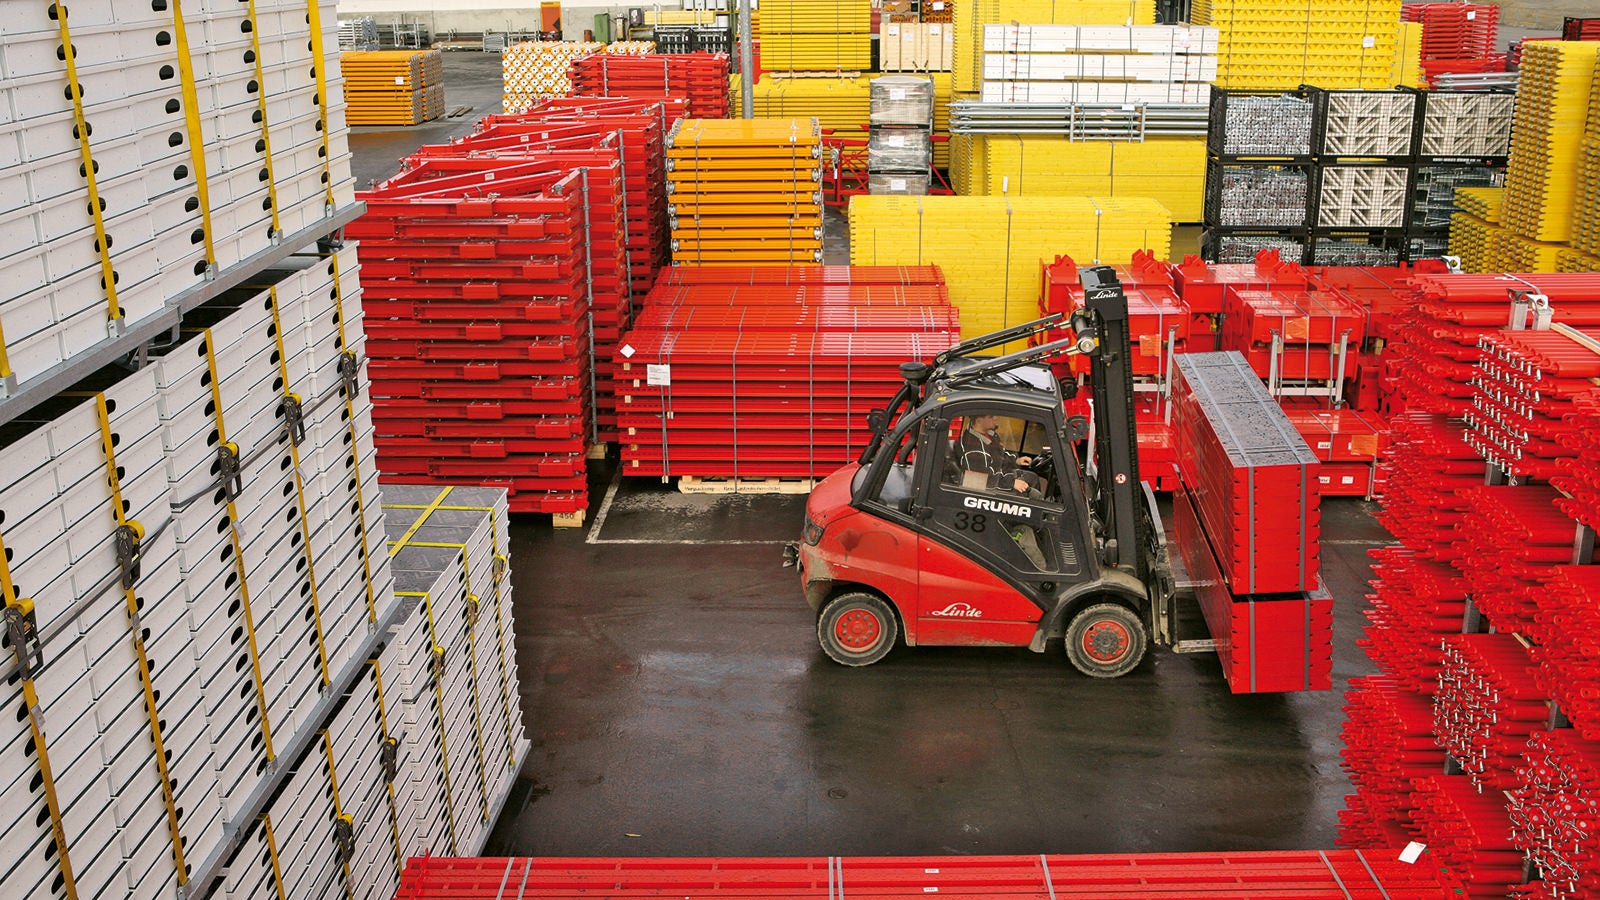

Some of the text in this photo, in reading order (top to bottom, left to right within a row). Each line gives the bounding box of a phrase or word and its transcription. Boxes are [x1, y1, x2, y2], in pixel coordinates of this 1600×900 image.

[1090, 289, 1118, 300] Linde
[963, 496, 1032, 518] GRUMA
[954, 511, 987, 533] 38
[931, 601, 983, 618] Linde
[54, 819, 69, 857] PERI
